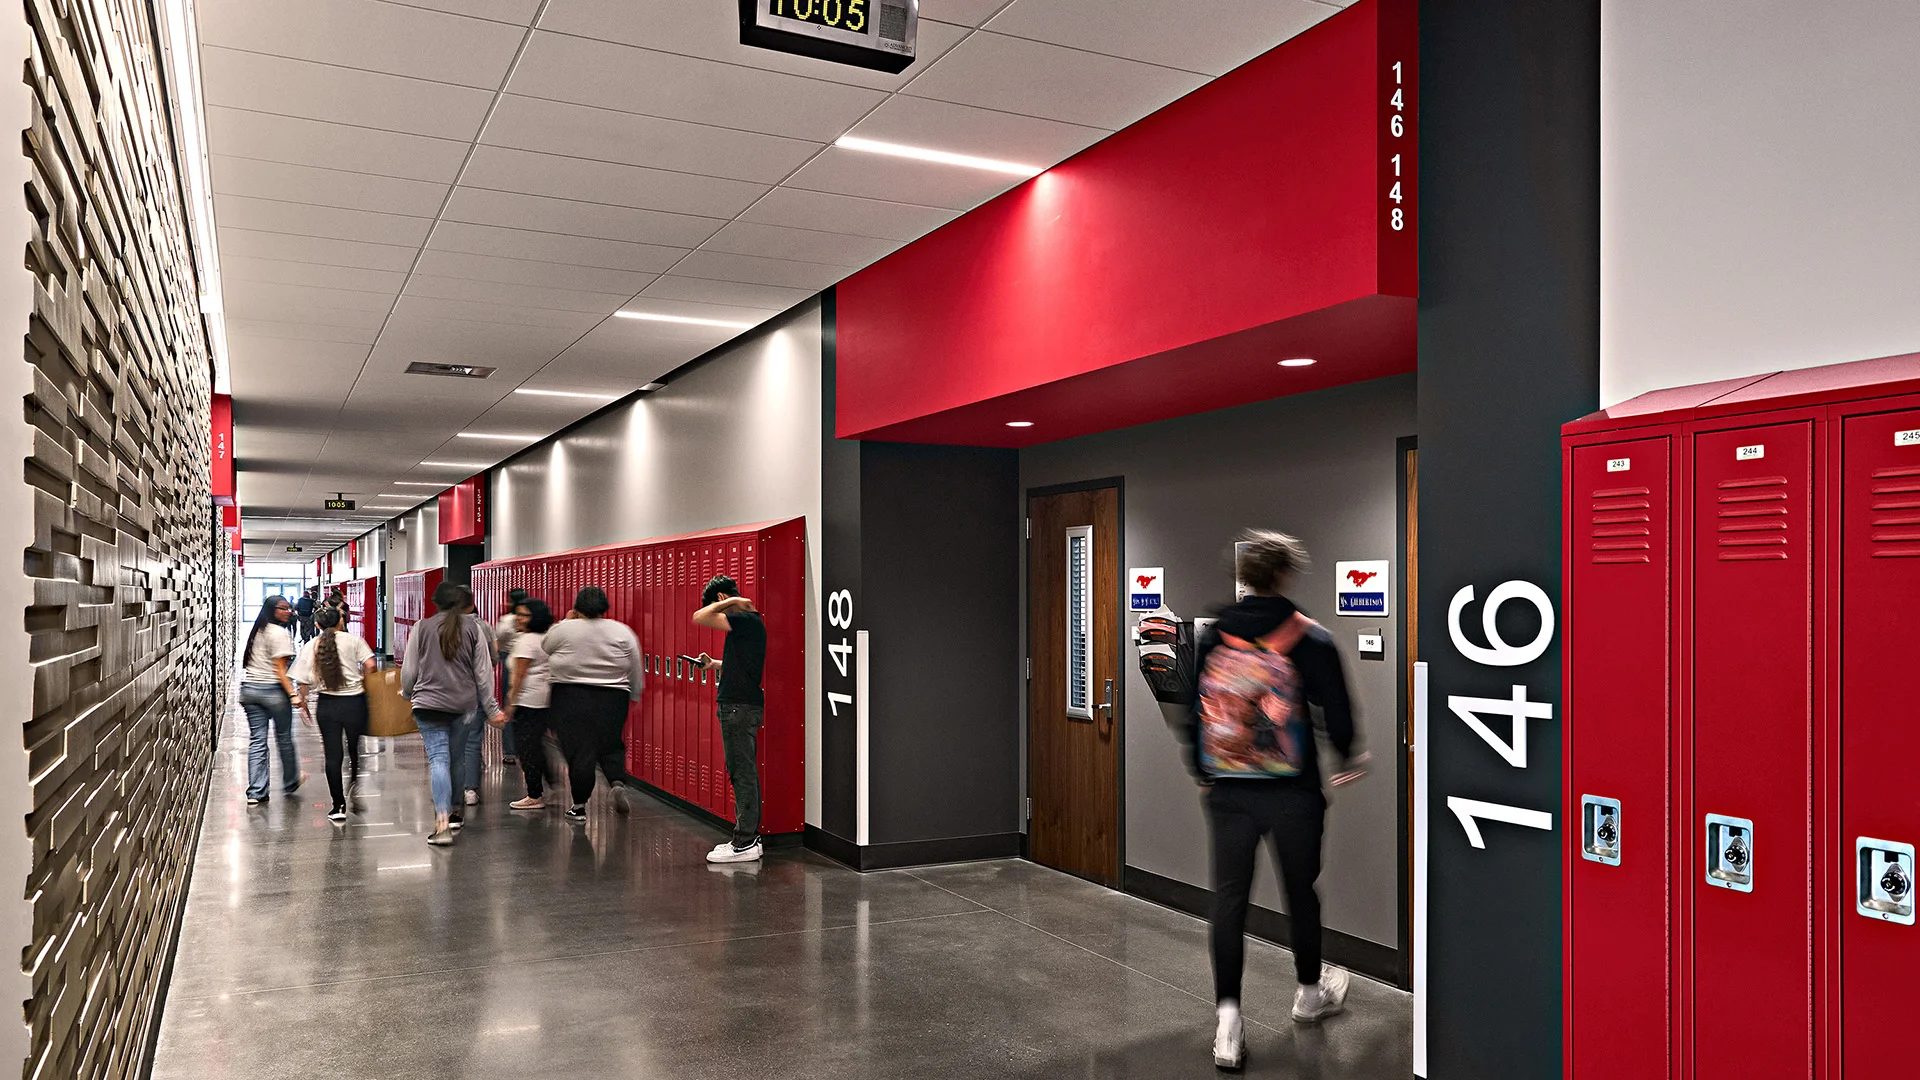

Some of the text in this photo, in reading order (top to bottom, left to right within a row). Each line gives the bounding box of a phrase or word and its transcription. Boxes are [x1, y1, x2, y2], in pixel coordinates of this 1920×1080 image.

[1389, 61, 1404, 231] 146 148
[217, 433, 225, 459] 147
[1903, 431, 1920, 441] 245
[1612, 460, 1625, 468] 243
[1743, 447, 1757, 456] 244
[827, 588, 853, 717] 148
[1447, 579, 1555, 850] 146
